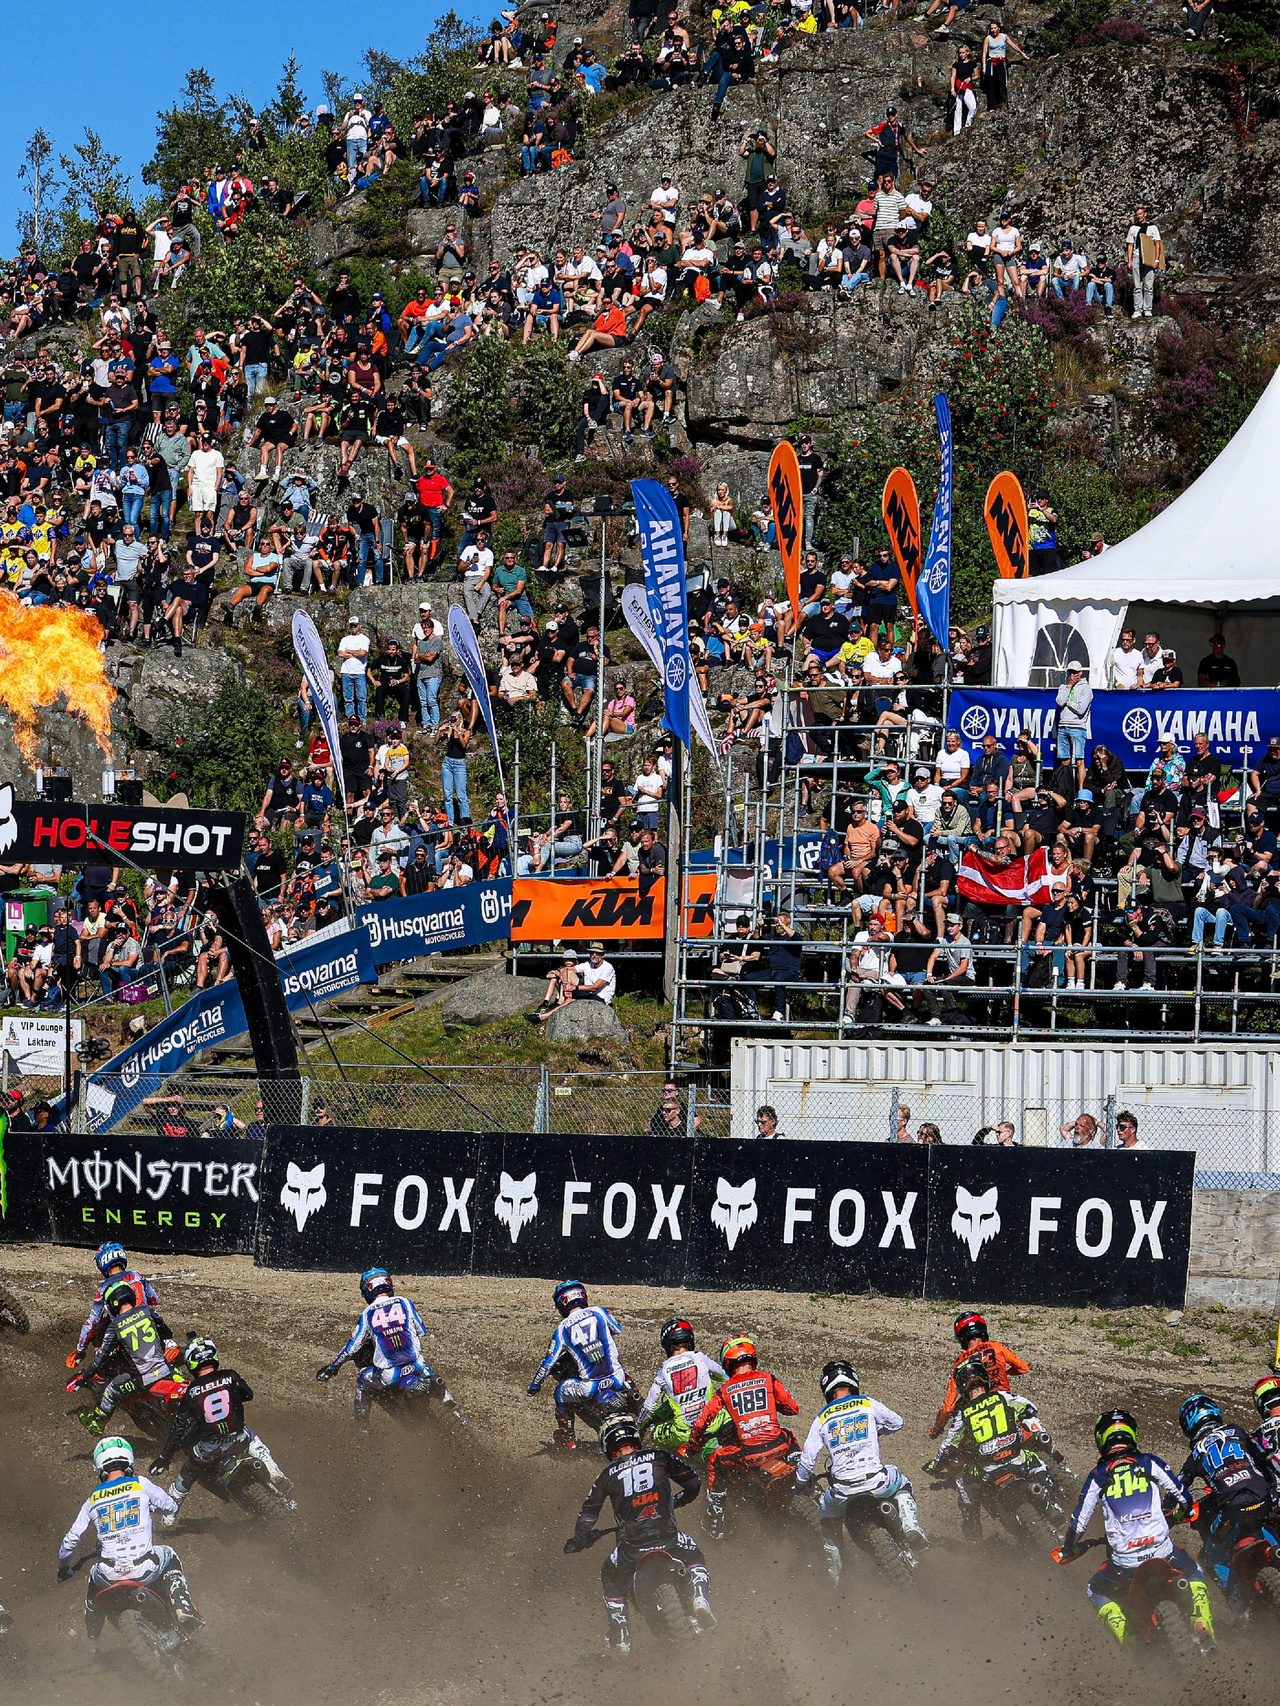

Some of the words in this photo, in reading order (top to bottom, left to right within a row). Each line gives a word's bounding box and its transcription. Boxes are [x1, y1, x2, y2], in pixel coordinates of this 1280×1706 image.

[992, 708, 1092, 739] YAMA
[1155, 710, 1260, 743] YAMAHA
[33, 817, 232, 856] HOLESHOT
[561, 887, 655, 927] KTM
[382, 908, 464, 940] Husqvarna
[425, 930, 465, 945] MOTORCYCLES
[283, 955, 357, 997] usqvarna
[21, 1022, 35, 1032] VIP
[36, 1022, 64, 1034] Lounge
[28, 1037, 56, 1048] Läktare
[47, 1150, 260, 1202] MONSTER
[82, 1207, 227, 1228] ENERGY
[350, 1173, 475, 1233] FOX
[562, 1181, 685, 1241] FOX
[782, 1187, 918, 1249] FOX
[1028, 1196, 1167, 1259] FOX
[371, 1303, 407, 1328] 44
[571, 1316, 598, 1346] 47
[120, 1318, 157, 1352] 73
[204, 1389, 230, 1423] 8
[730, 1387, 768, 1416] 489
[970, 1403, 1008, 1443] 51
[1206, 1441, 1245, 1469] 14
[93, 1484, 132, 1501] LÜNING
[618, 1462, 655, 1497] 18
[1137, 1551, 1156, 1562] BRIX
